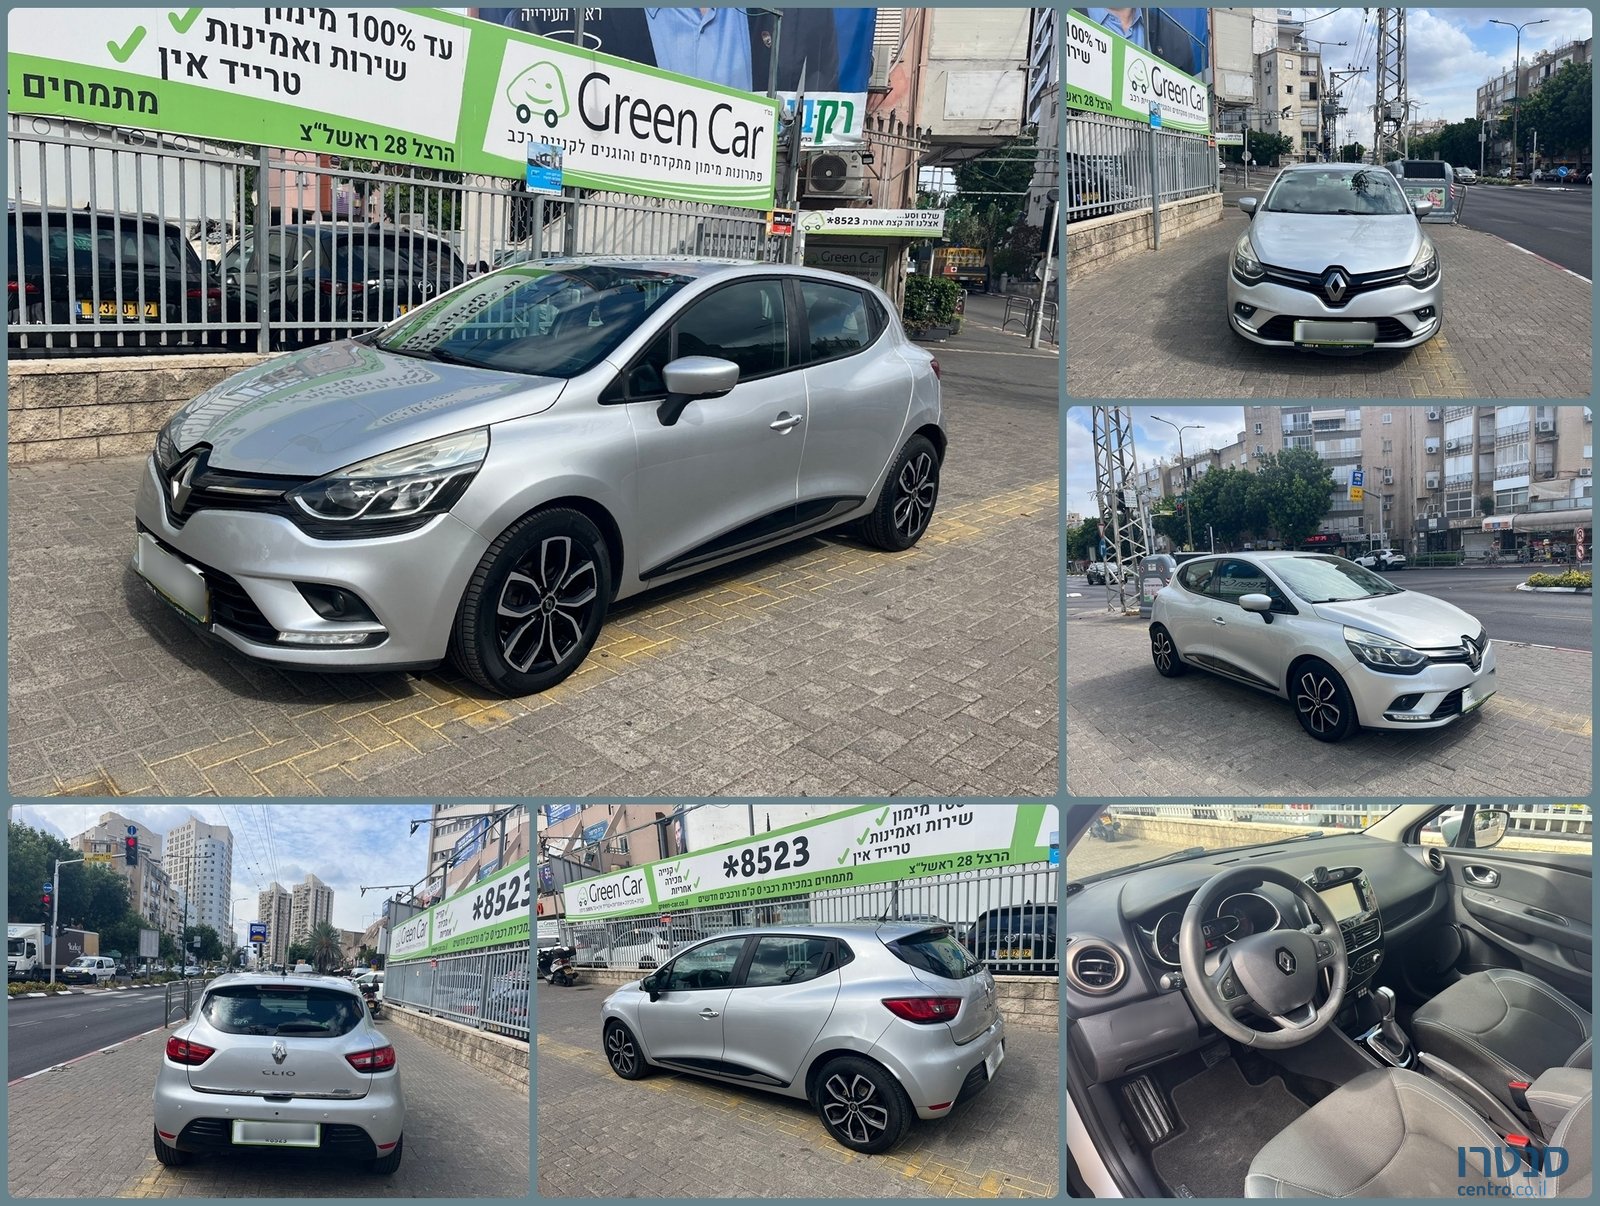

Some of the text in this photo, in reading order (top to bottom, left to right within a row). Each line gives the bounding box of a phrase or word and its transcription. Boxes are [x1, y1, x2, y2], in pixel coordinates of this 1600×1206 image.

[347, 12, 416, 52] 100%
[205, 17, 407, 81] שירות ואמינות
[423, 34, 453, 60] עד
[1094, 38, 1107, 54] עד
[158, 46, 301, 96] טרייד אין
[23, 73, 158, 115] מתמחים
[1151, 66, 1205, 112] Green Car
[1083, 94, 1094, 107] 28
[1095, 99, 1113, 112] הרצל
[578, 72, 764, 160] Green Car
[507, 129, 534, 144] רכב
[384, 134, 407, 156] 28
[412, 137, 455, 163] הרצל
[591, 144, 635, 162] והוגנים
[640, 152, 691, 171] מתקדמים
[695, 161, 722, 176] מימון
[725, 166, 763, 182] פתרונות
[885, 219, 903, 228] קצת
[904, 219, 915, 227] זה
[916, 219, 939, 227] אצלנו
[921, 212, 940, 220] שלם
[820, 250, 881, 264] Green Car
[893, 804, 930, 826] מימון
[869, 812, 973, 844] שירות ואמינות
[853, 841, 911, 866] טרייד אין
[957, 855, 972, 867] 28
[976, 850, 1010, 864] הרצל
[658, 866, 674, 877] קנייה
[815, 872, 853, 886] מתמחים
[664, 875, 683, 886] מכירה
[781, 878, 812, 892] במכירת
[588, 875, 643, 903] Green Car
[671, 884, 692, 895] אחריות
[763, 883, 780, 894] רכבי
[401, 919, 428, 944] Green Car
[261, 1069, 296, 1077] CLIO
